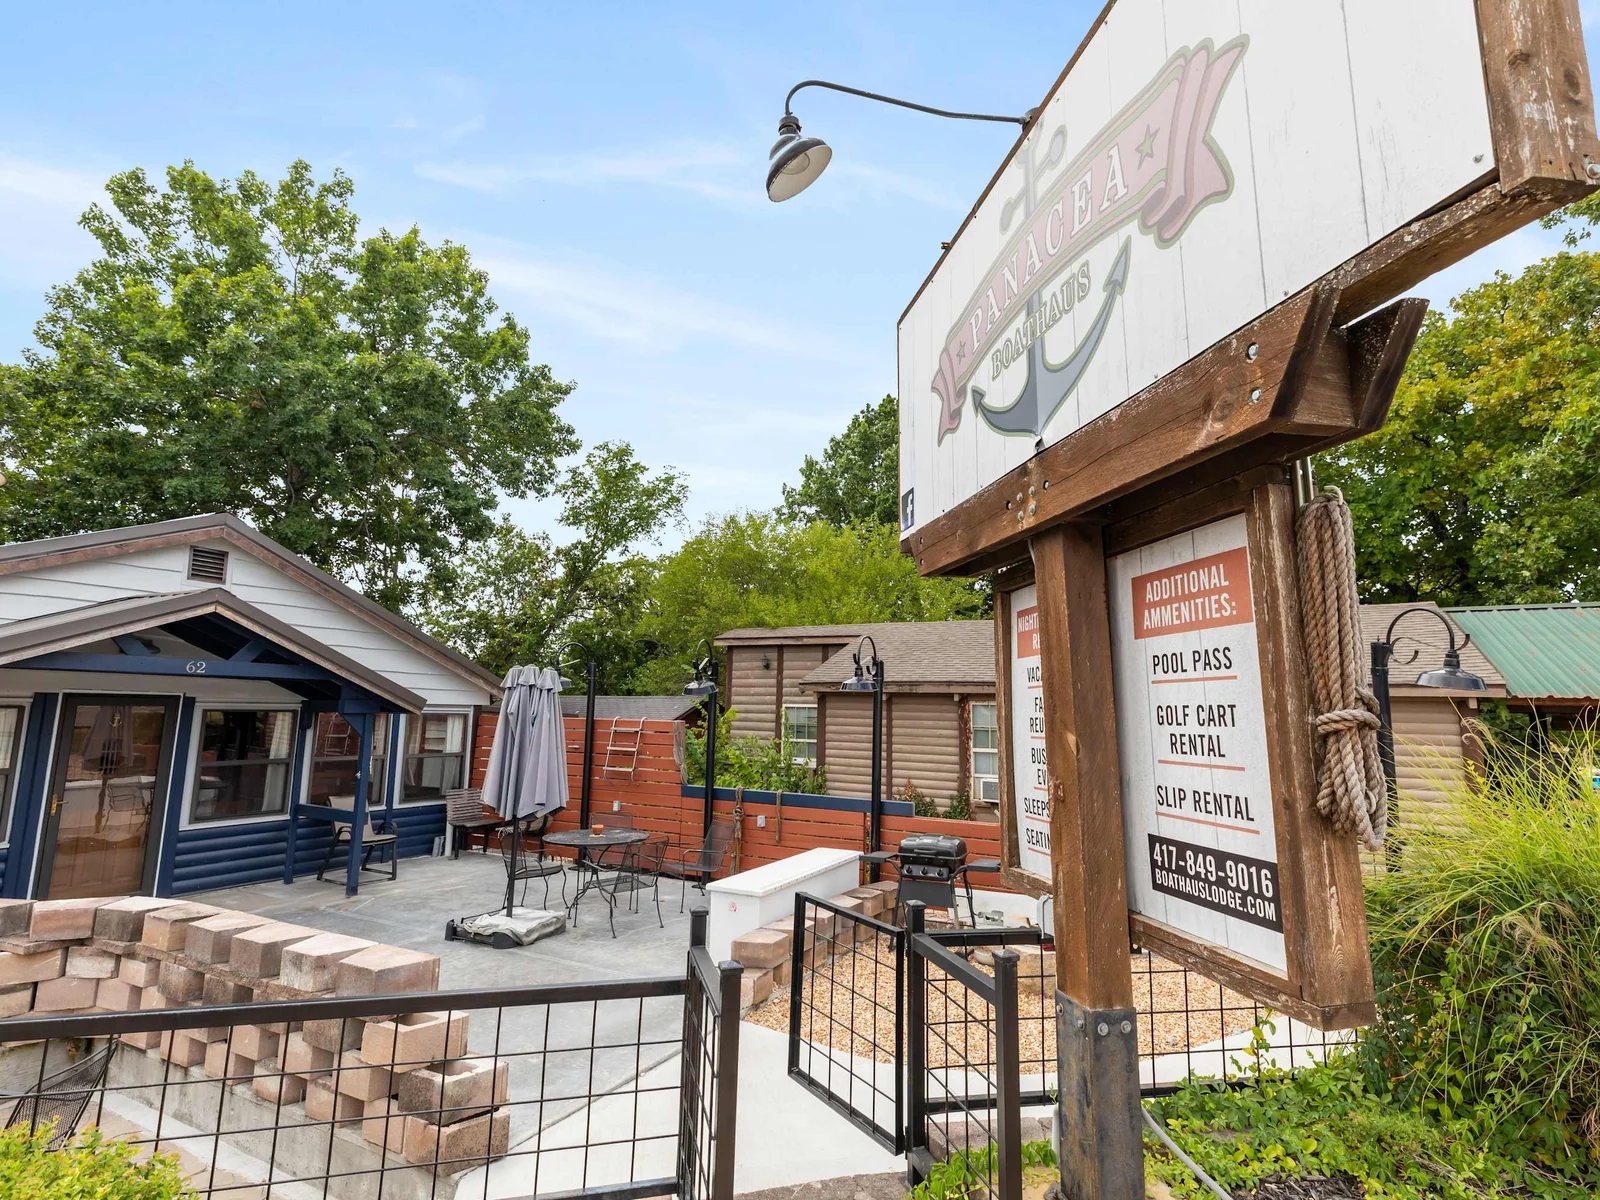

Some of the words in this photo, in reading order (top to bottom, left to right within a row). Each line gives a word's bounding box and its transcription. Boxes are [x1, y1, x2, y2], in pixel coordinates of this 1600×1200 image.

[969, 145, 1128, 353] PANACEA
[992, 260, 1090, 380] BOATHAUS
[1146, 563, 1229, 603] ADDITIONAL
[1144, 592, 1237, 630] AMMENITIES:
[186, 661, 206, 673] 62
[1027, 666, 1042, 682] VAC
[1152, 651, 1188, 675] POOL
[1193, 646, 1233, 672] PASS
[1156, 704, 1190, 727] GOLF
[1196, 704, 1237, 728] CART
[1169, 733, 1226, 758] RENTAL
[1156, 785, 1187, 809] SLIP
[1193, 790, 1255, 822] RENTAL
[1153, 842, 1274, 898] 417-849-9016
[1155, 868, 1276, 922] BOATHAUSLODGE.COM
